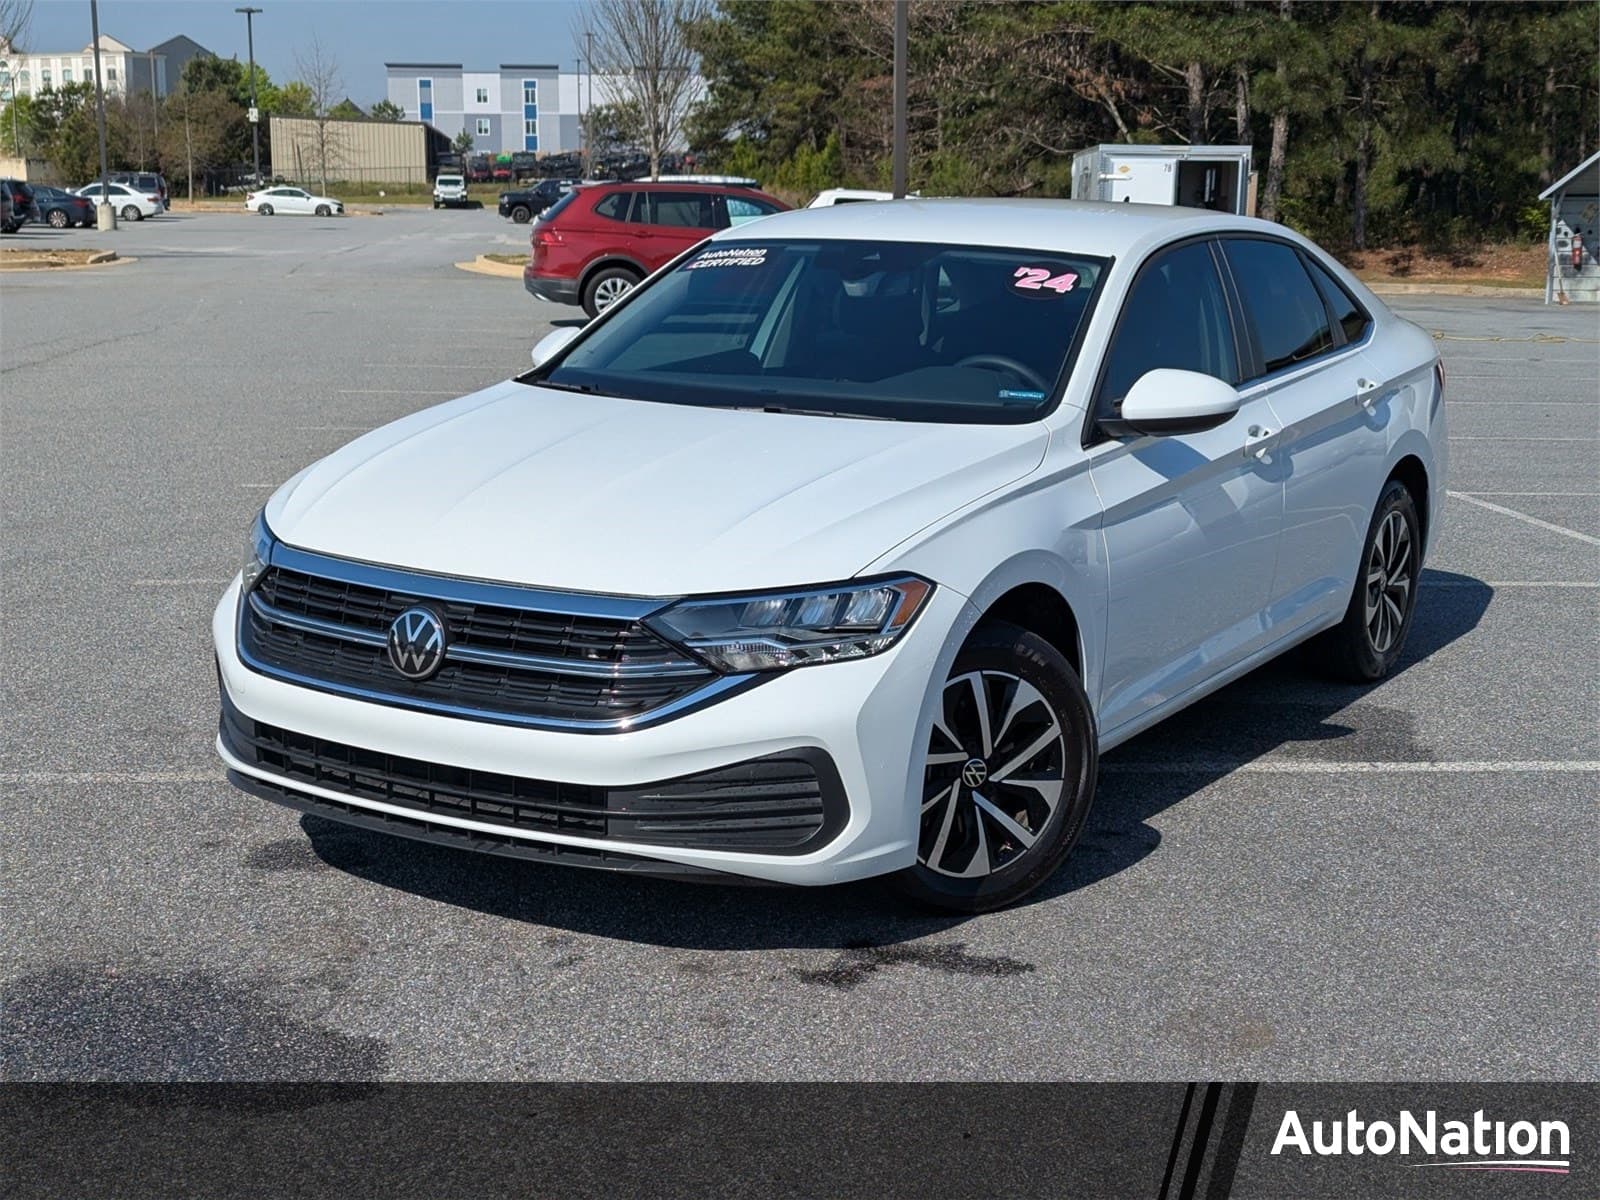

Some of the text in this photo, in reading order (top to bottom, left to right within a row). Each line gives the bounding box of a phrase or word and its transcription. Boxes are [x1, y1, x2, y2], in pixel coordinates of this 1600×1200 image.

[692, 257, 766, 269] CERTIFIED
[697, 248, 768, 260] AutoNation
[1014, 266, 1078, 293] '24
[391, 609, 443, 677] VW
